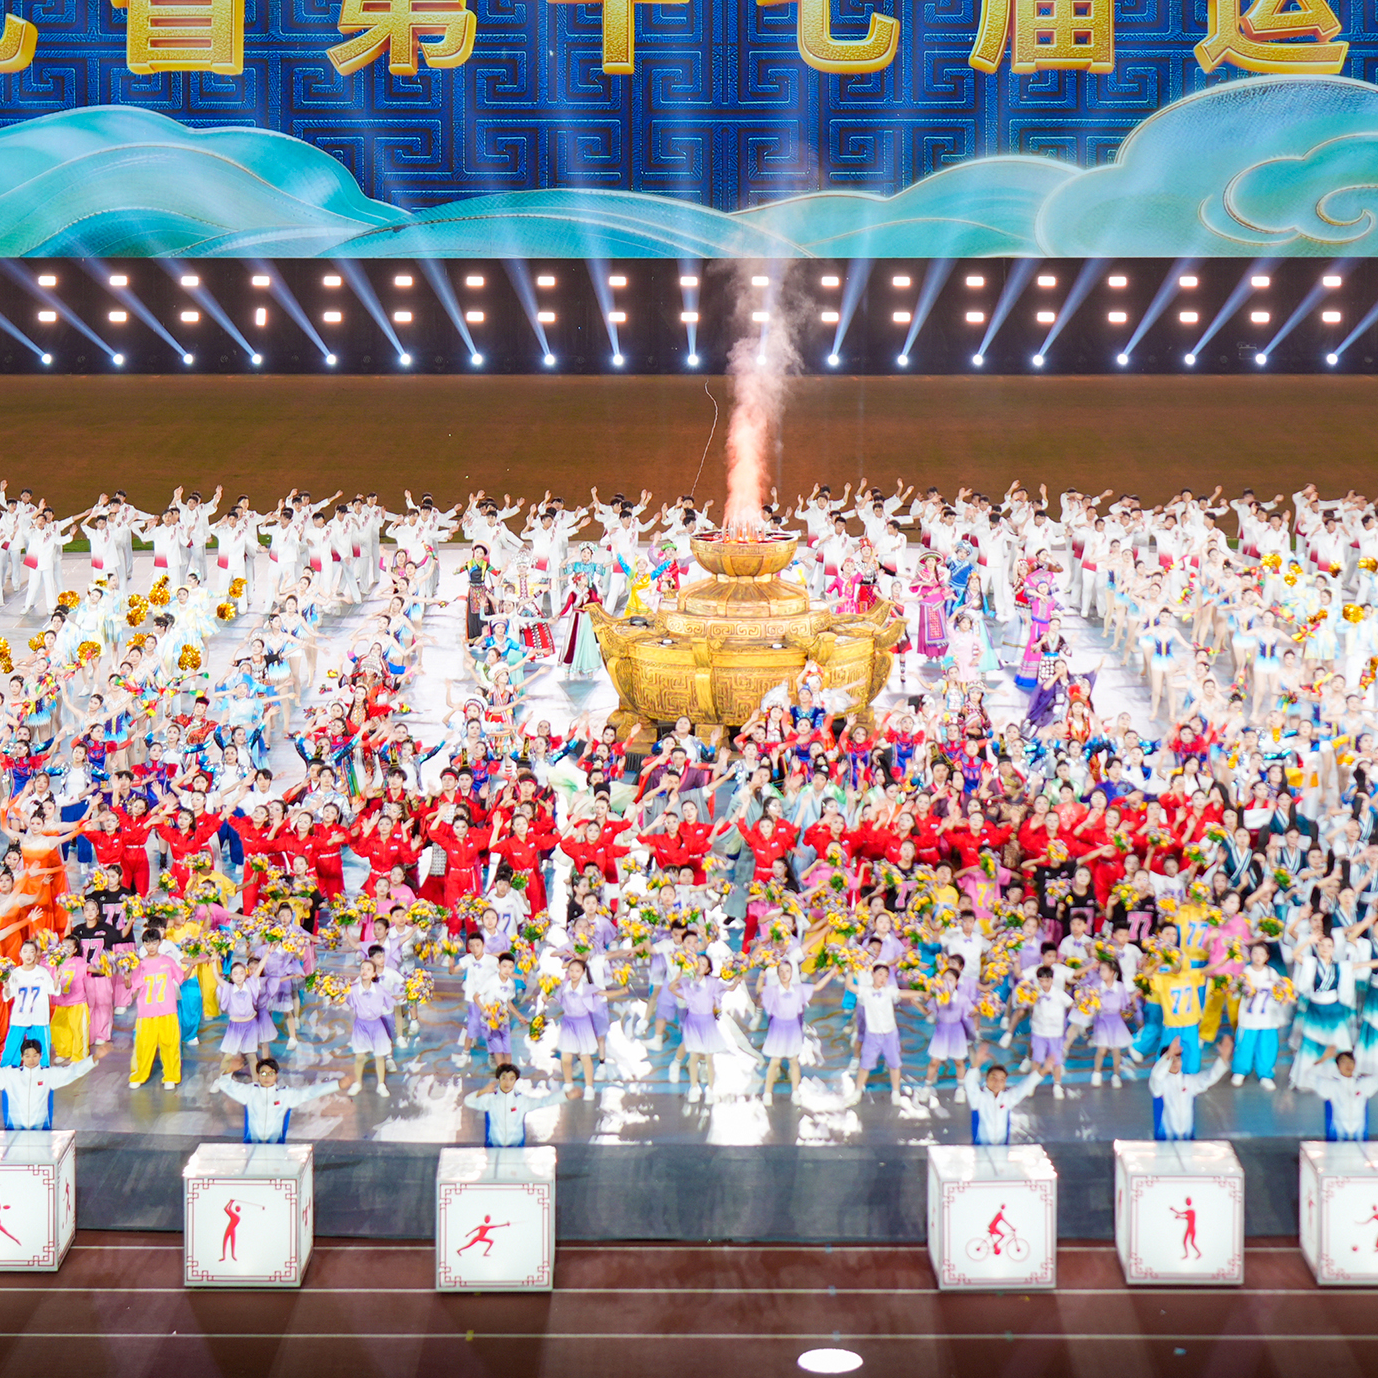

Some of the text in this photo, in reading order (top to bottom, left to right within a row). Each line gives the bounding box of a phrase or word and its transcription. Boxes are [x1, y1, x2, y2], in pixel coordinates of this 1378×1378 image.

[1127, 910, 1154, 942] 77
[18, 986, 41, 1013] 77
[143, 972, 169, 1005] 77
[1170, 984, 1193, 1015] 77
